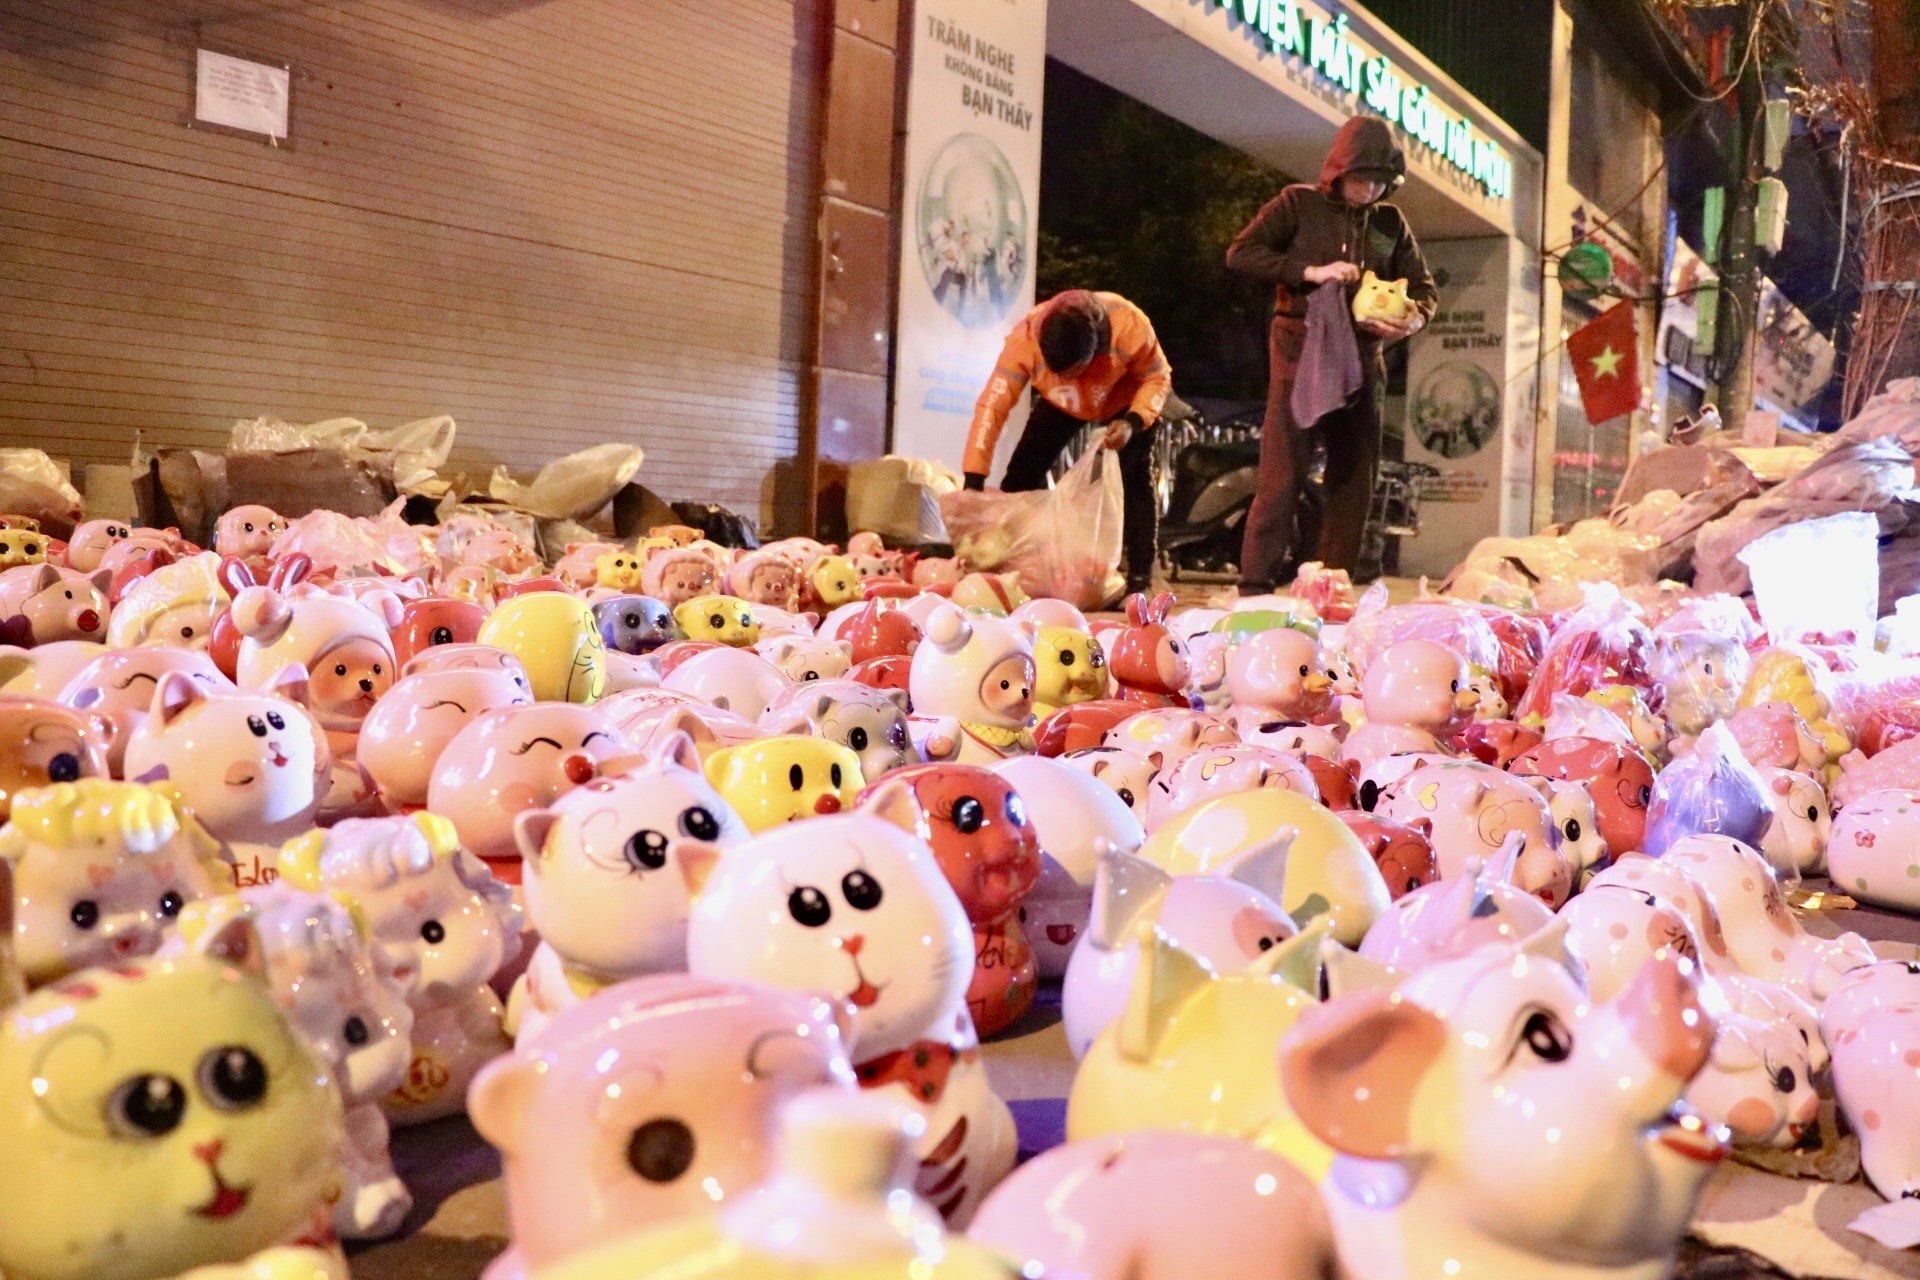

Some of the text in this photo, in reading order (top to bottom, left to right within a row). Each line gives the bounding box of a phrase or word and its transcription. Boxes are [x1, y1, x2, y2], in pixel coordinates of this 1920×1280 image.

[927, 15, 1015, 75] TRĂM NGHE
[961, 83, 1033, 132] BẠN THẤY
[1311, 13, 1365, 95] MẮT
[1366, 55, 1400, 122] SÀI
[1402, 84, 1448, 154] GÒN
